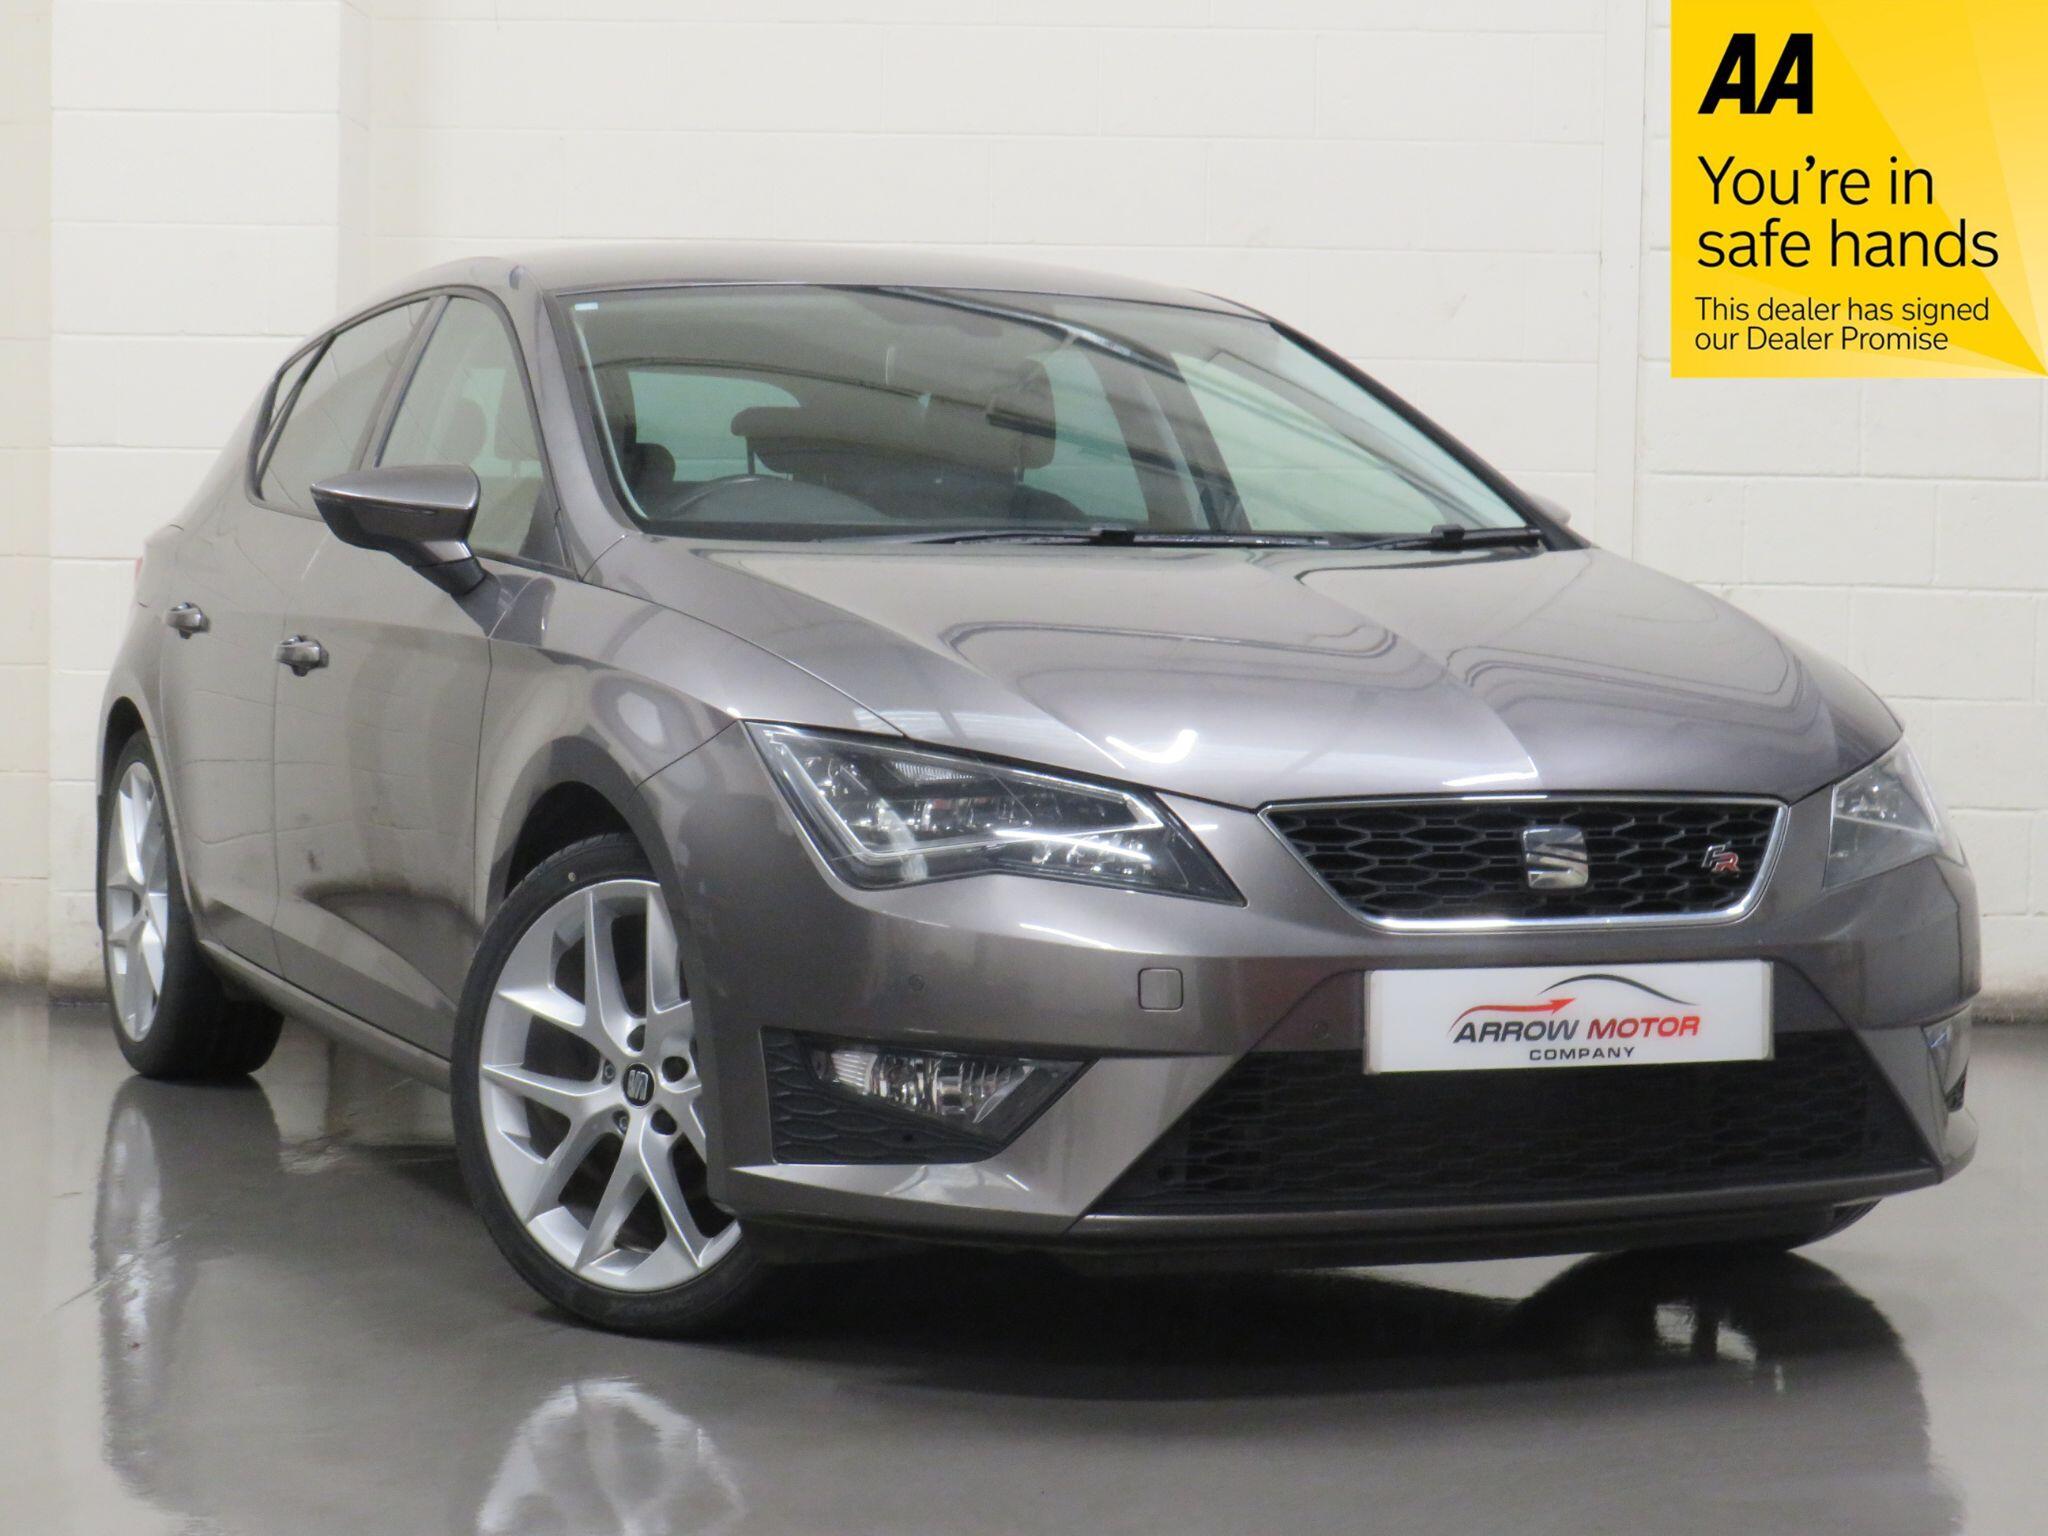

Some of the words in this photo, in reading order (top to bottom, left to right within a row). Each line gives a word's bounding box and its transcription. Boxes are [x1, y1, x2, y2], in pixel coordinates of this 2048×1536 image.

[1701, 844, 1740, 873] FR
[1453, 1020, 1580, 1044] ARROW
[1587, 1016, 1701, 1040] MOTOR
[1529, 1047, 1635, 1061] COMPANY
